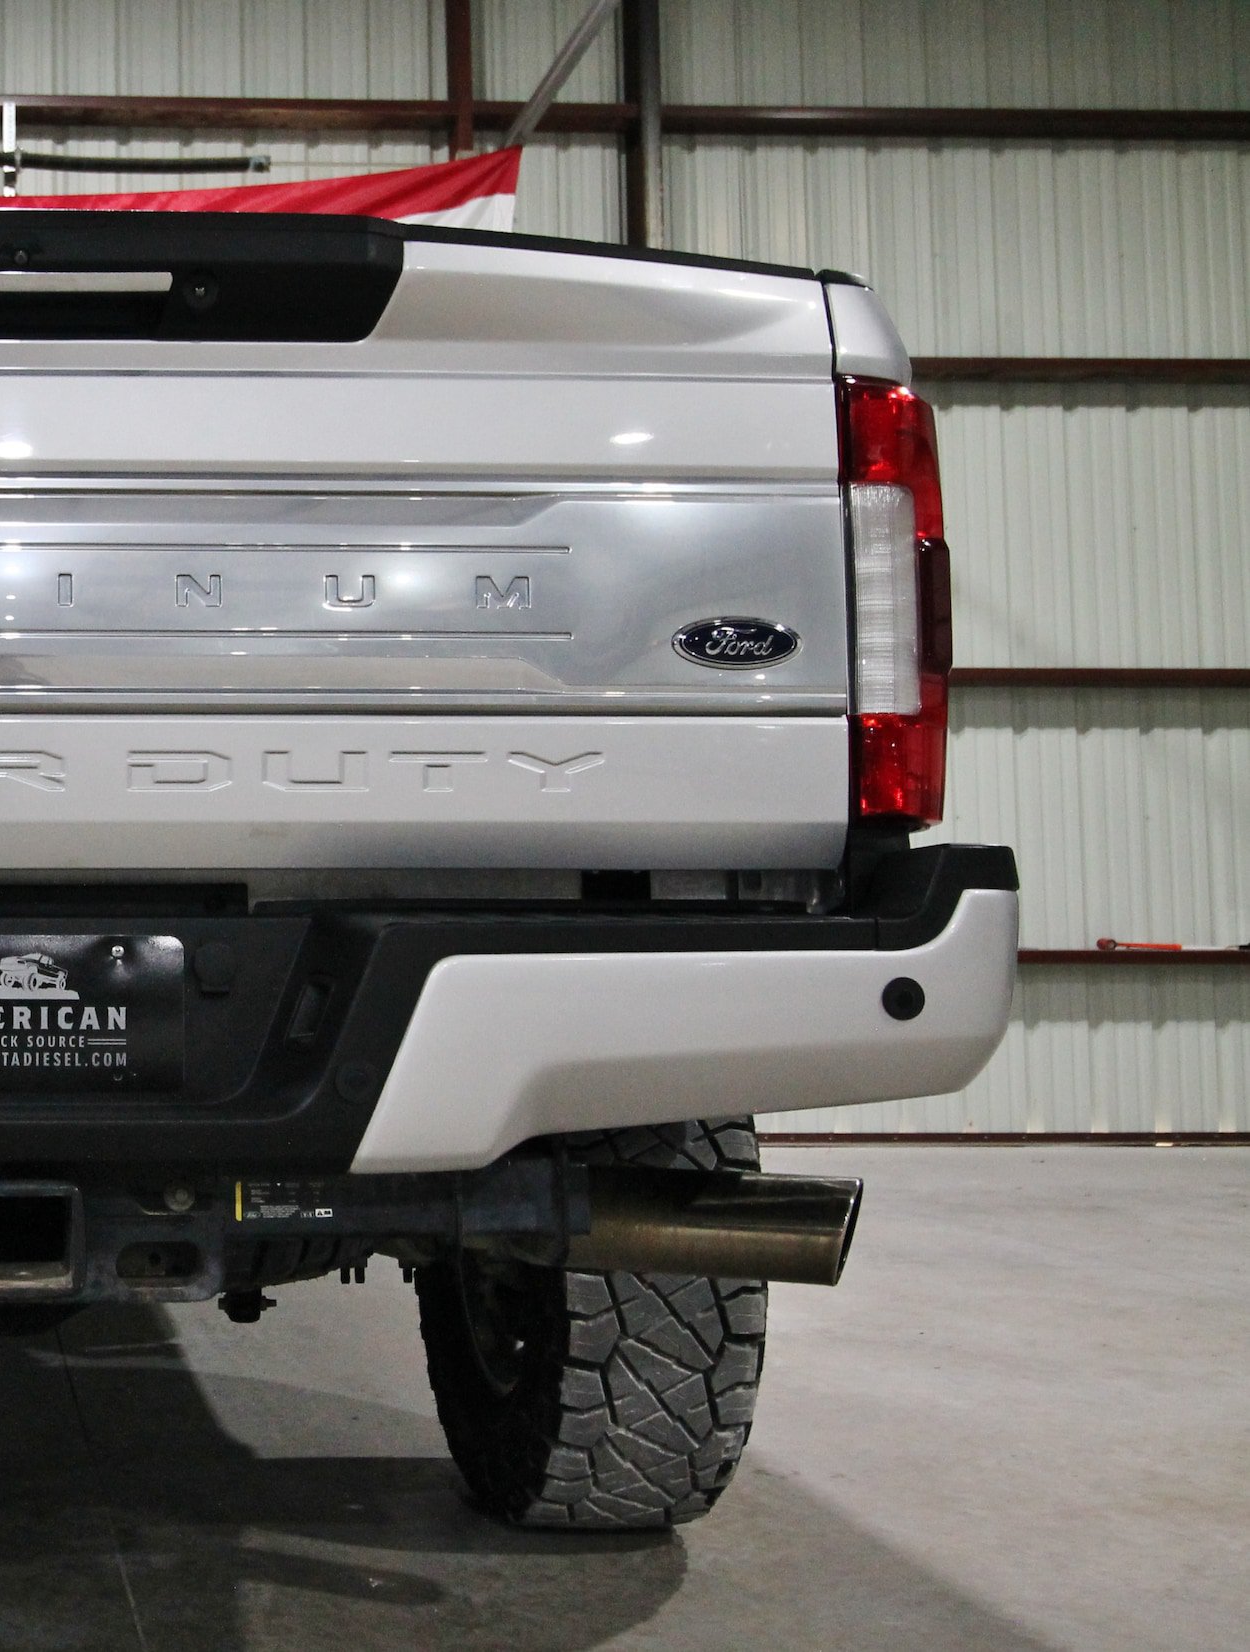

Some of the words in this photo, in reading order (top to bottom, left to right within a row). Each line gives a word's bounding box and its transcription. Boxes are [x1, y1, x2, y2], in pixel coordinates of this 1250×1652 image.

[704, 626, 775, 656] Ford
[126, 749, 606, 793] DUTY
[26, 1035, 85, 1048] SOURCE
